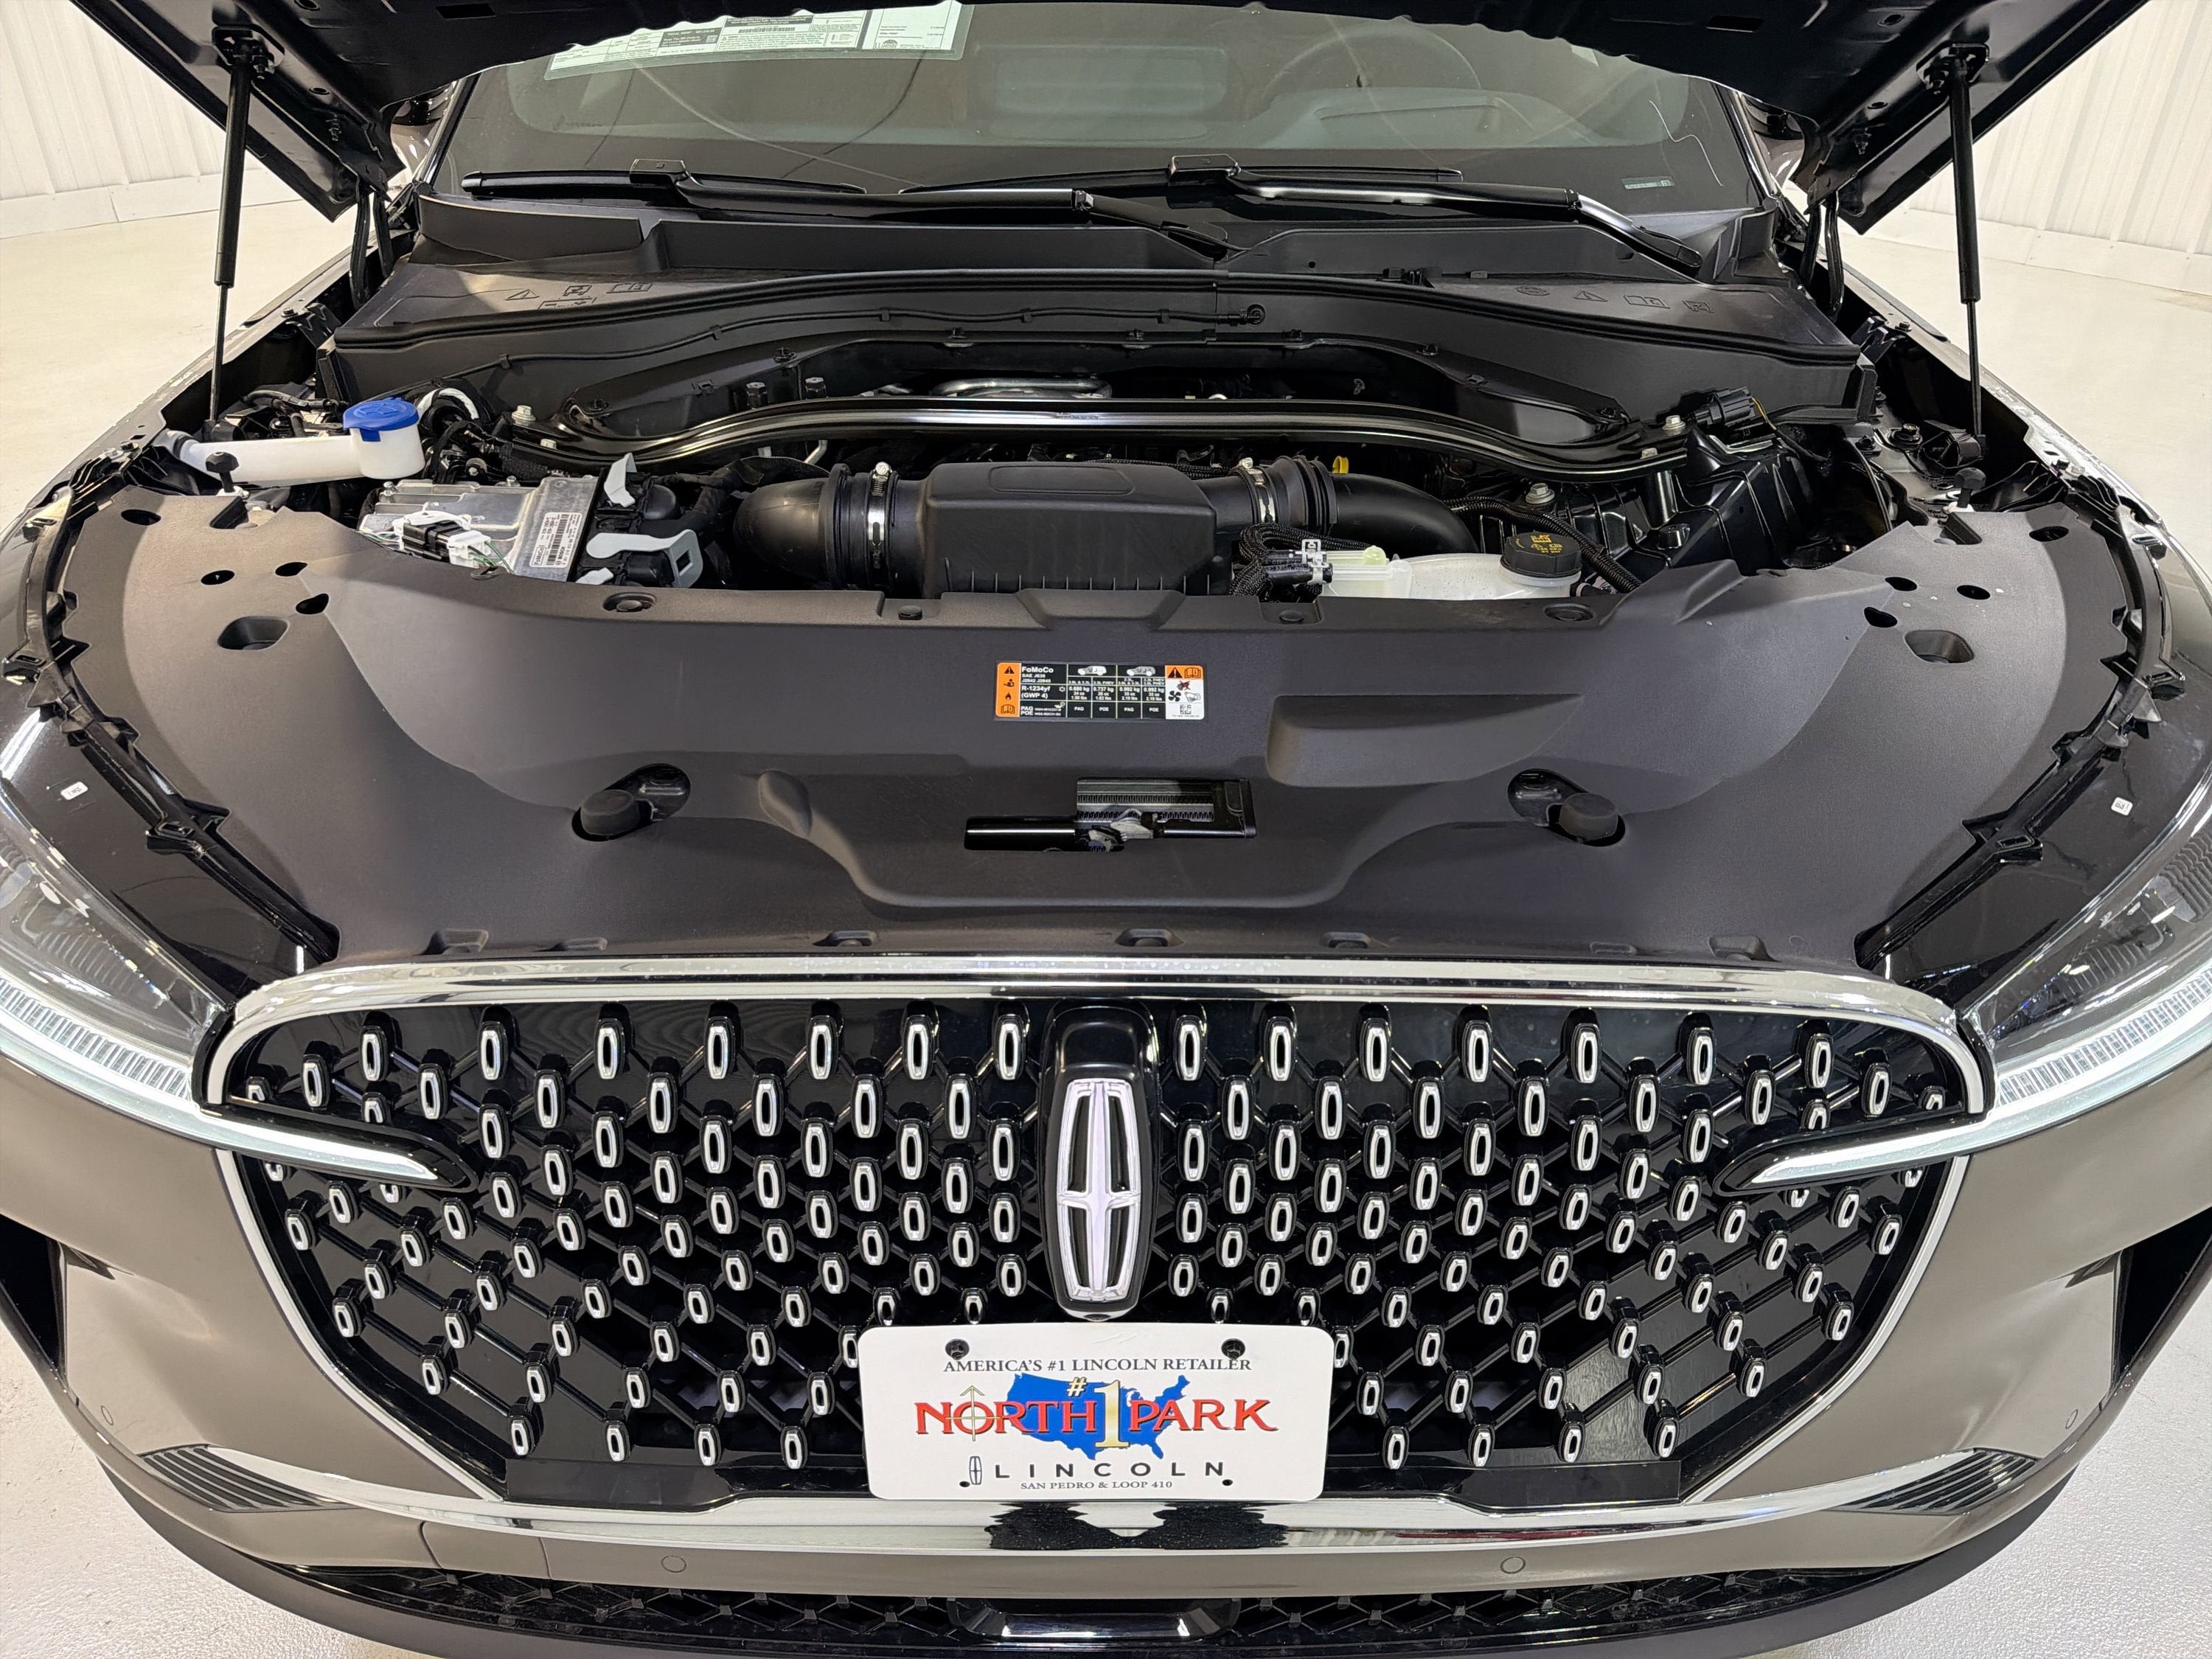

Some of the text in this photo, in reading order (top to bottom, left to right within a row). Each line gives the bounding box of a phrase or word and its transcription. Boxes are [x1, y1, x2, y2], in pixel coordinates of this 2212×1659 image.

[943, 1357, 1252, 1372] AMERICA'S #1 LINCOLN RETAILER
[914, 1399, 1098, 1435] NORTH
[1128, 1399, 1280, 1432] PARK
[995, 1461, 1223, 1478] LINCOLN
[1020, 1481, 1172, 1489] SAN PEDRO & LOOP 410
